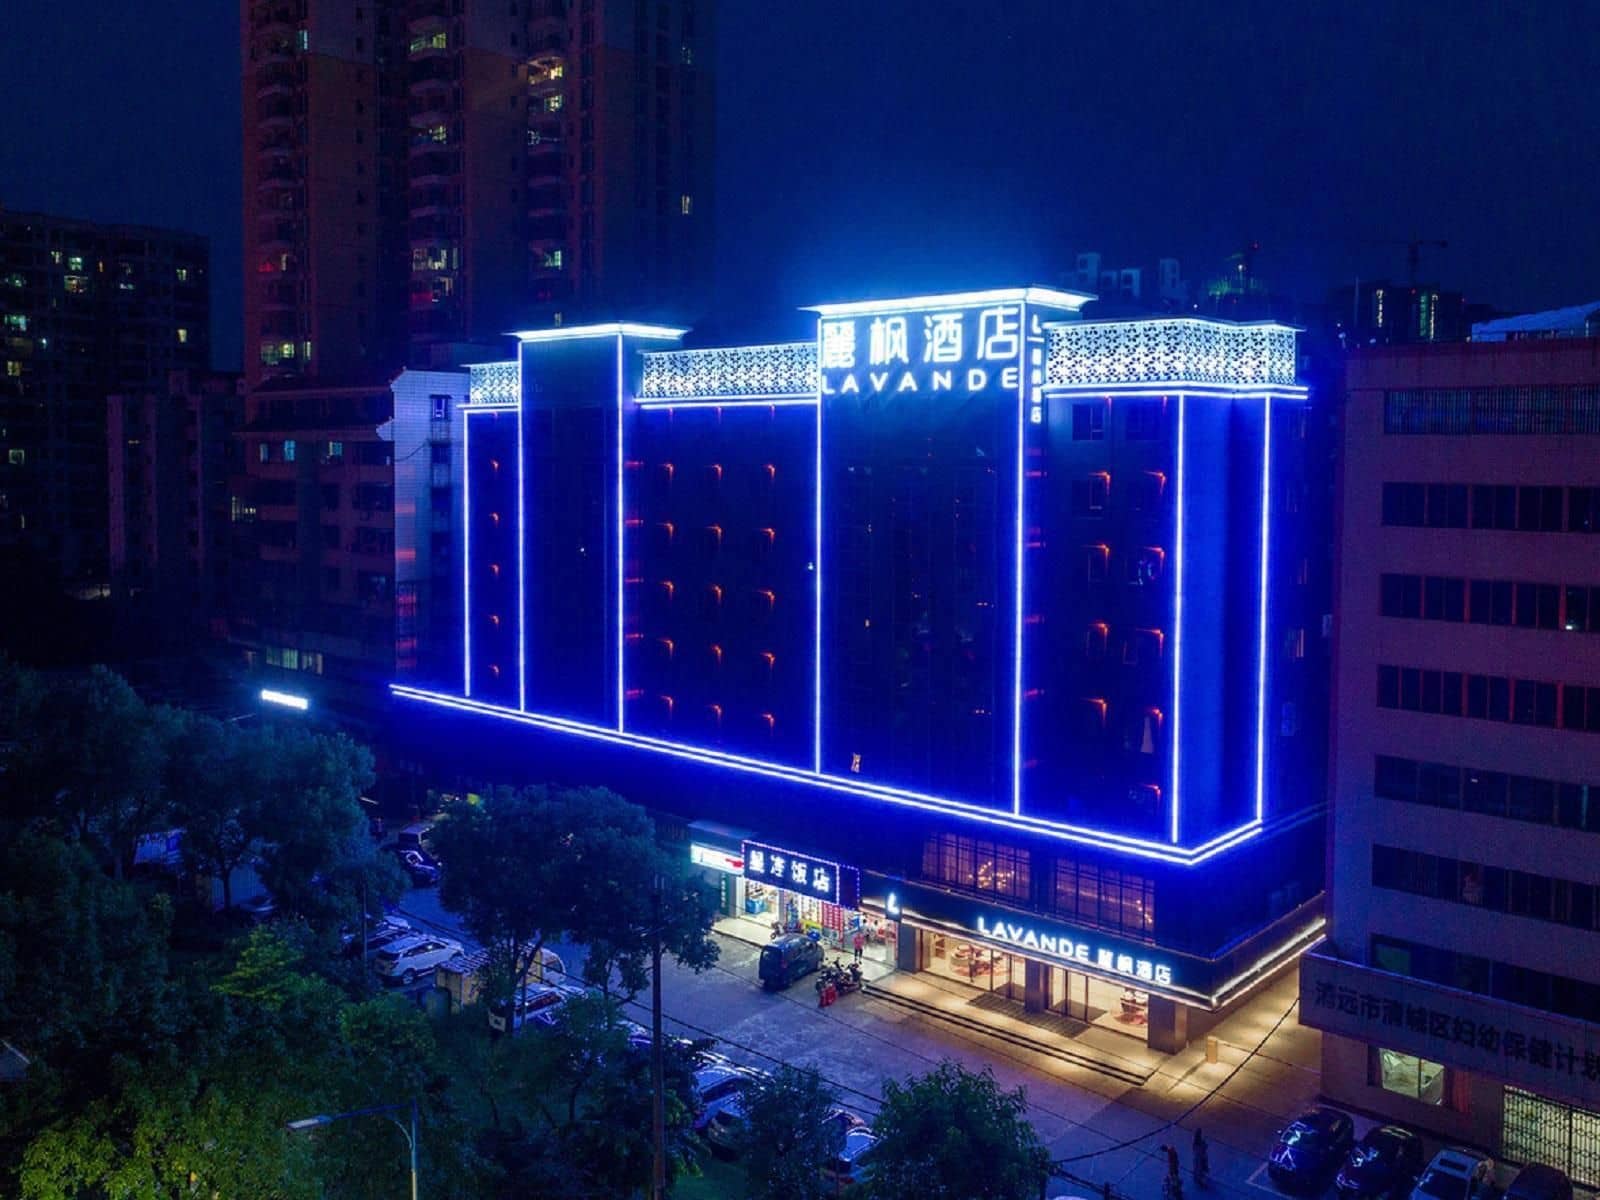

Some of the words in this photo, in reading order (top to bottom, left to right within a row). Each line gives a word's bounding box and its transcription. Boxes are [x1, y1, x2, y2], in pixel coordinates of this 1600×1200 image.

[821, 367, 1019, 394] LAVANDE
[887, 892, 900, 915] L
[976, 916, 1090, 962] LAVANDE
